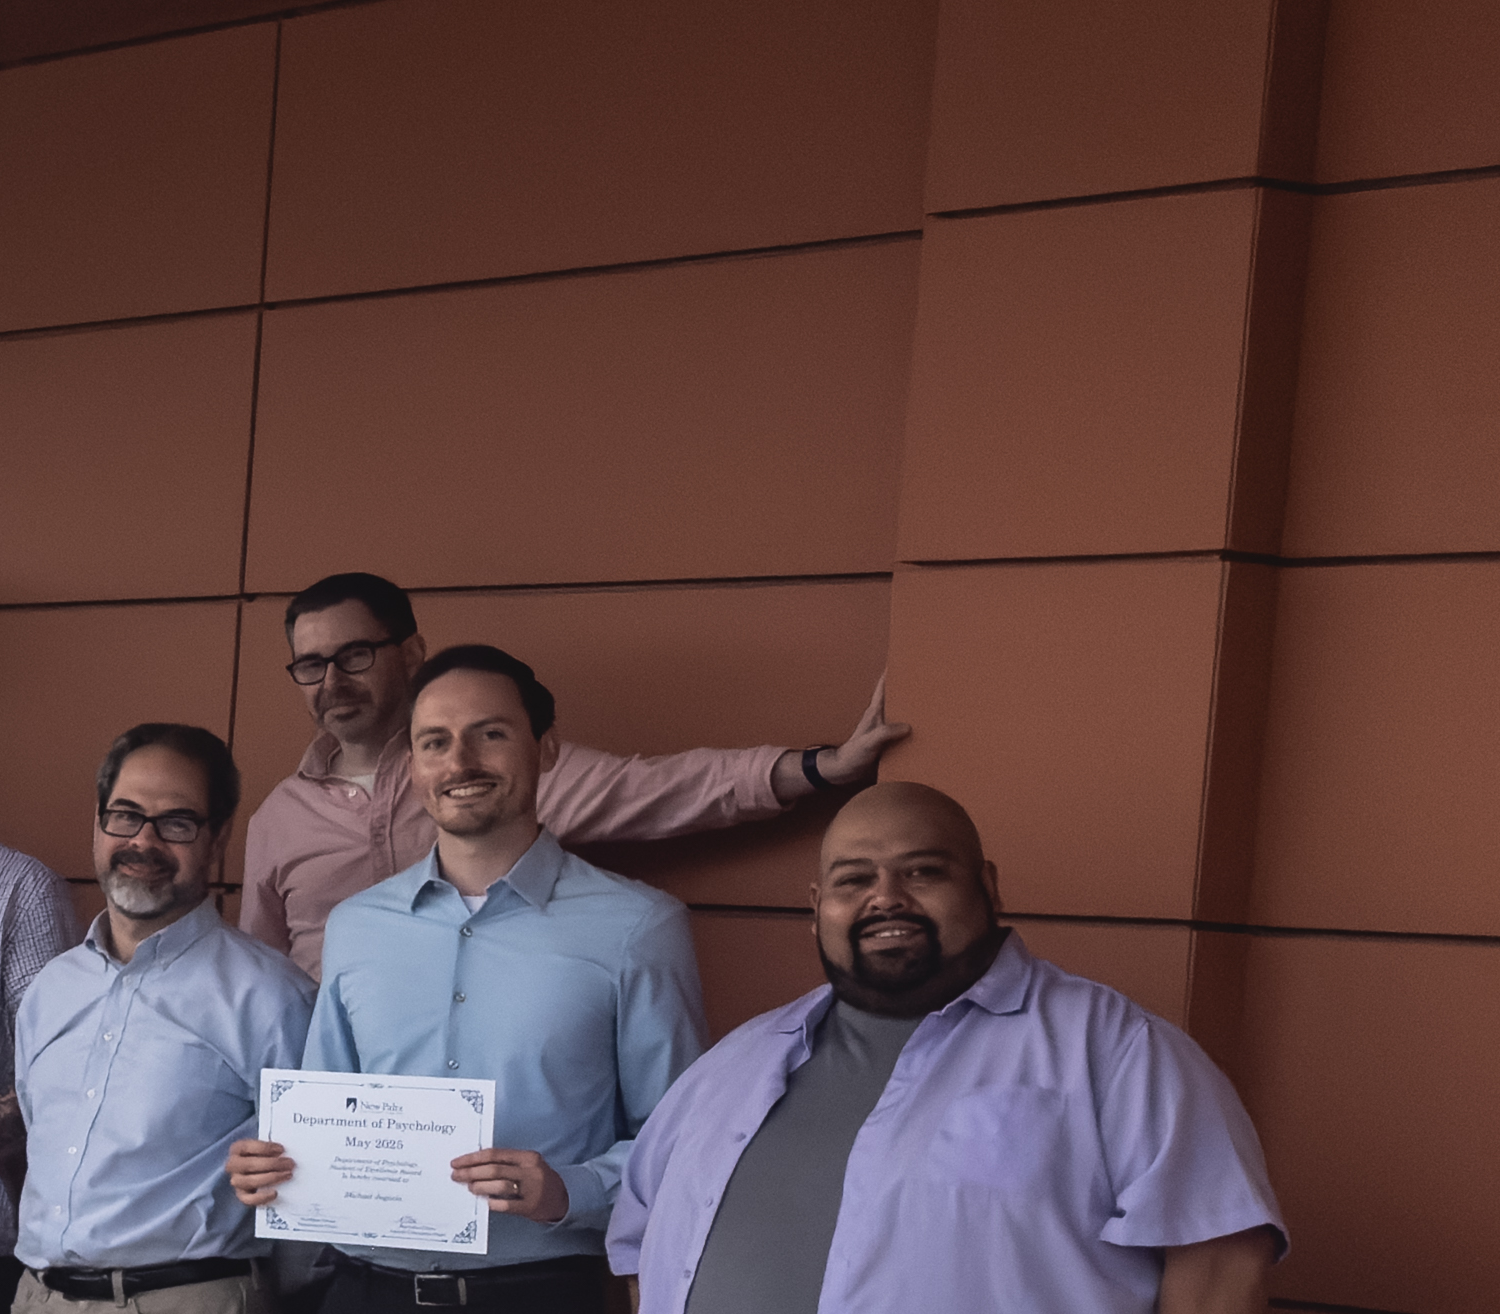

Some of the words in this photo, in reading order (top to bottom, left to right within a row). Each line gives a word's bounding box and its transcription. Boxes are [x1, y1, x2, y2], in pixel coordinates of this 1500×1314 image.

[360, 1100, 380, 1110] New
[293, 1112, 366, 1127] Department
[371, 1118, 384, 1128] of
[386, 1118, 456, 1135] Psychology
[345, 1135, 371, 1149] May
[374, 1138, 403, 1149] 2025
